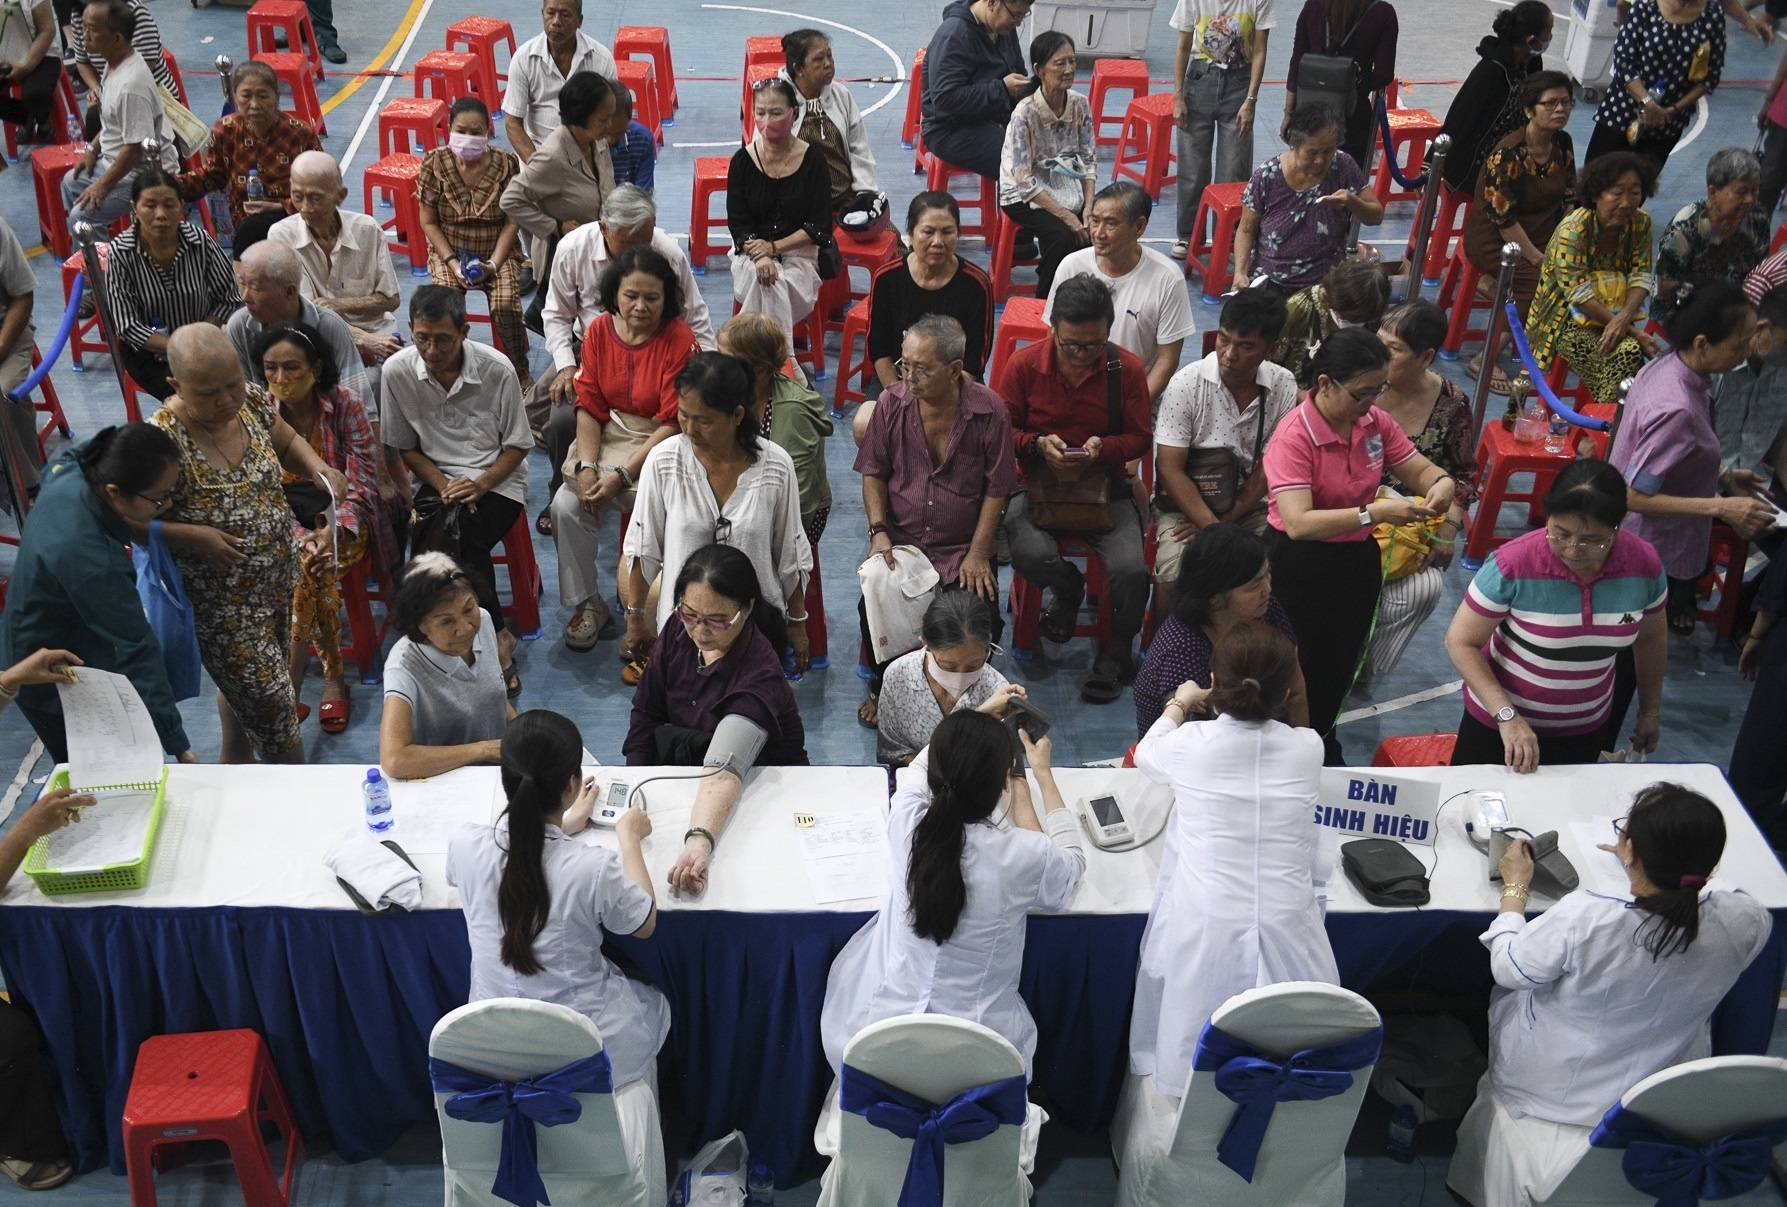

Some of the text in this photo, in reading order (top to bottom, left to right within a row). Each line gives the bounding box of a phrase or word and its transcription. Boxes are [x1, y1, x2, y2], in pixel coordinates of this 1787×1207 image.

[1347, 778, 1397, 805] BÀN
[1313, 804, 1429, 842] SINH HIỆU
